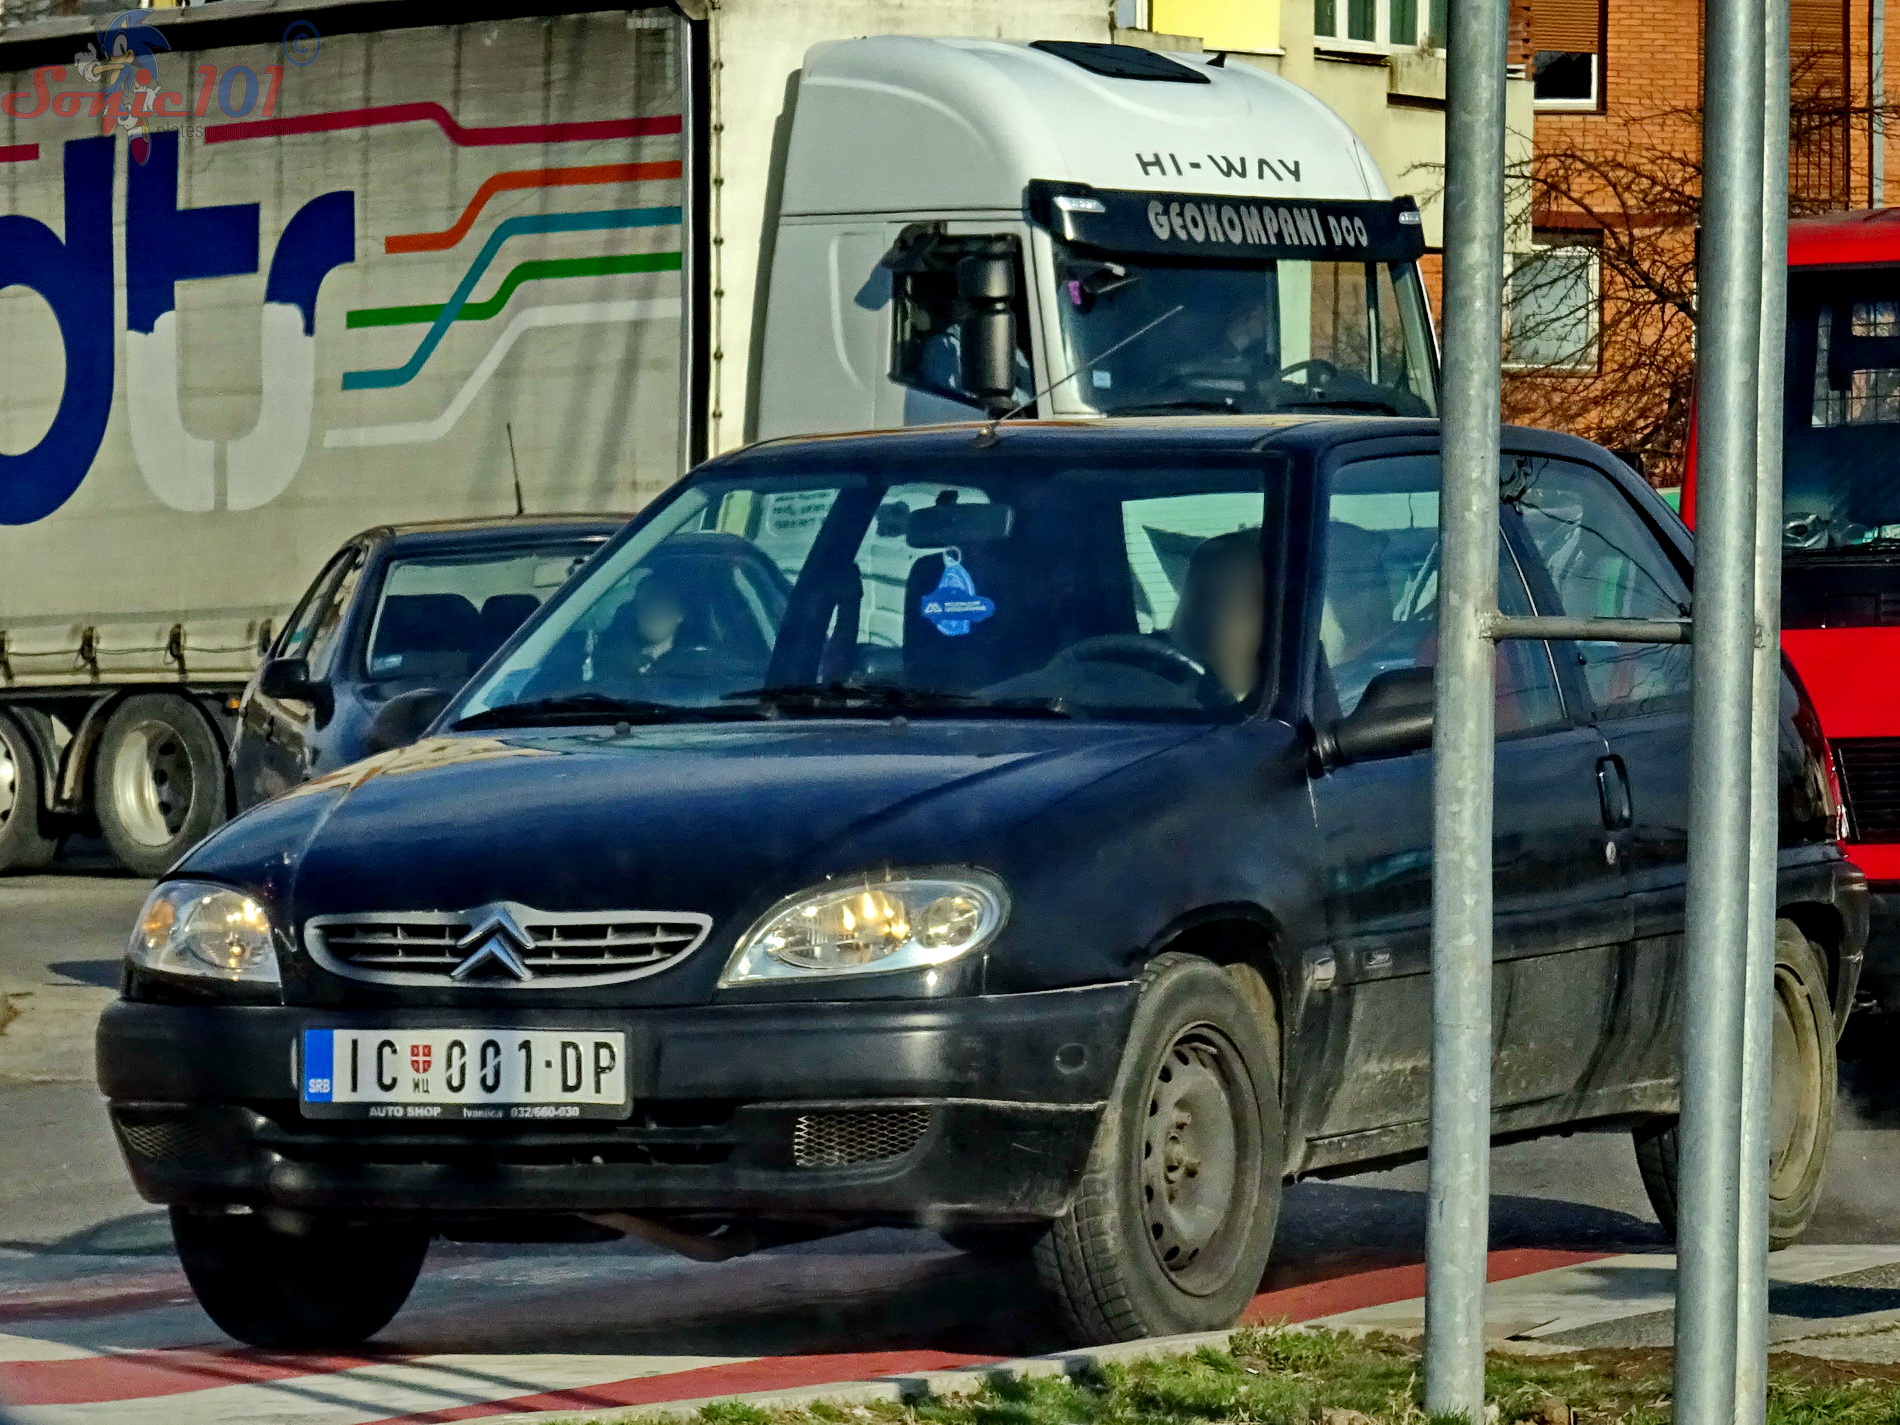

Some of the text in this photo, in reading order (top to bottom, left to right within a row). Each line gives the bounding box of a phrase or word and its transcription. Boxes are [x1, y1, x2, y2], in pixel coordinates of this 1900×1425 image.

[1135, 152, 1302, 183] HI-WAY
[1148, 200, 1369, 248] GEOKOMPANI DOO
[350, 1038, 398, 1093] IC
[308, 1078, 331, 1094] SRB
[369, 1105, 404, 1118] AUTO
[406, 1105, 441, 1118] SHOP
